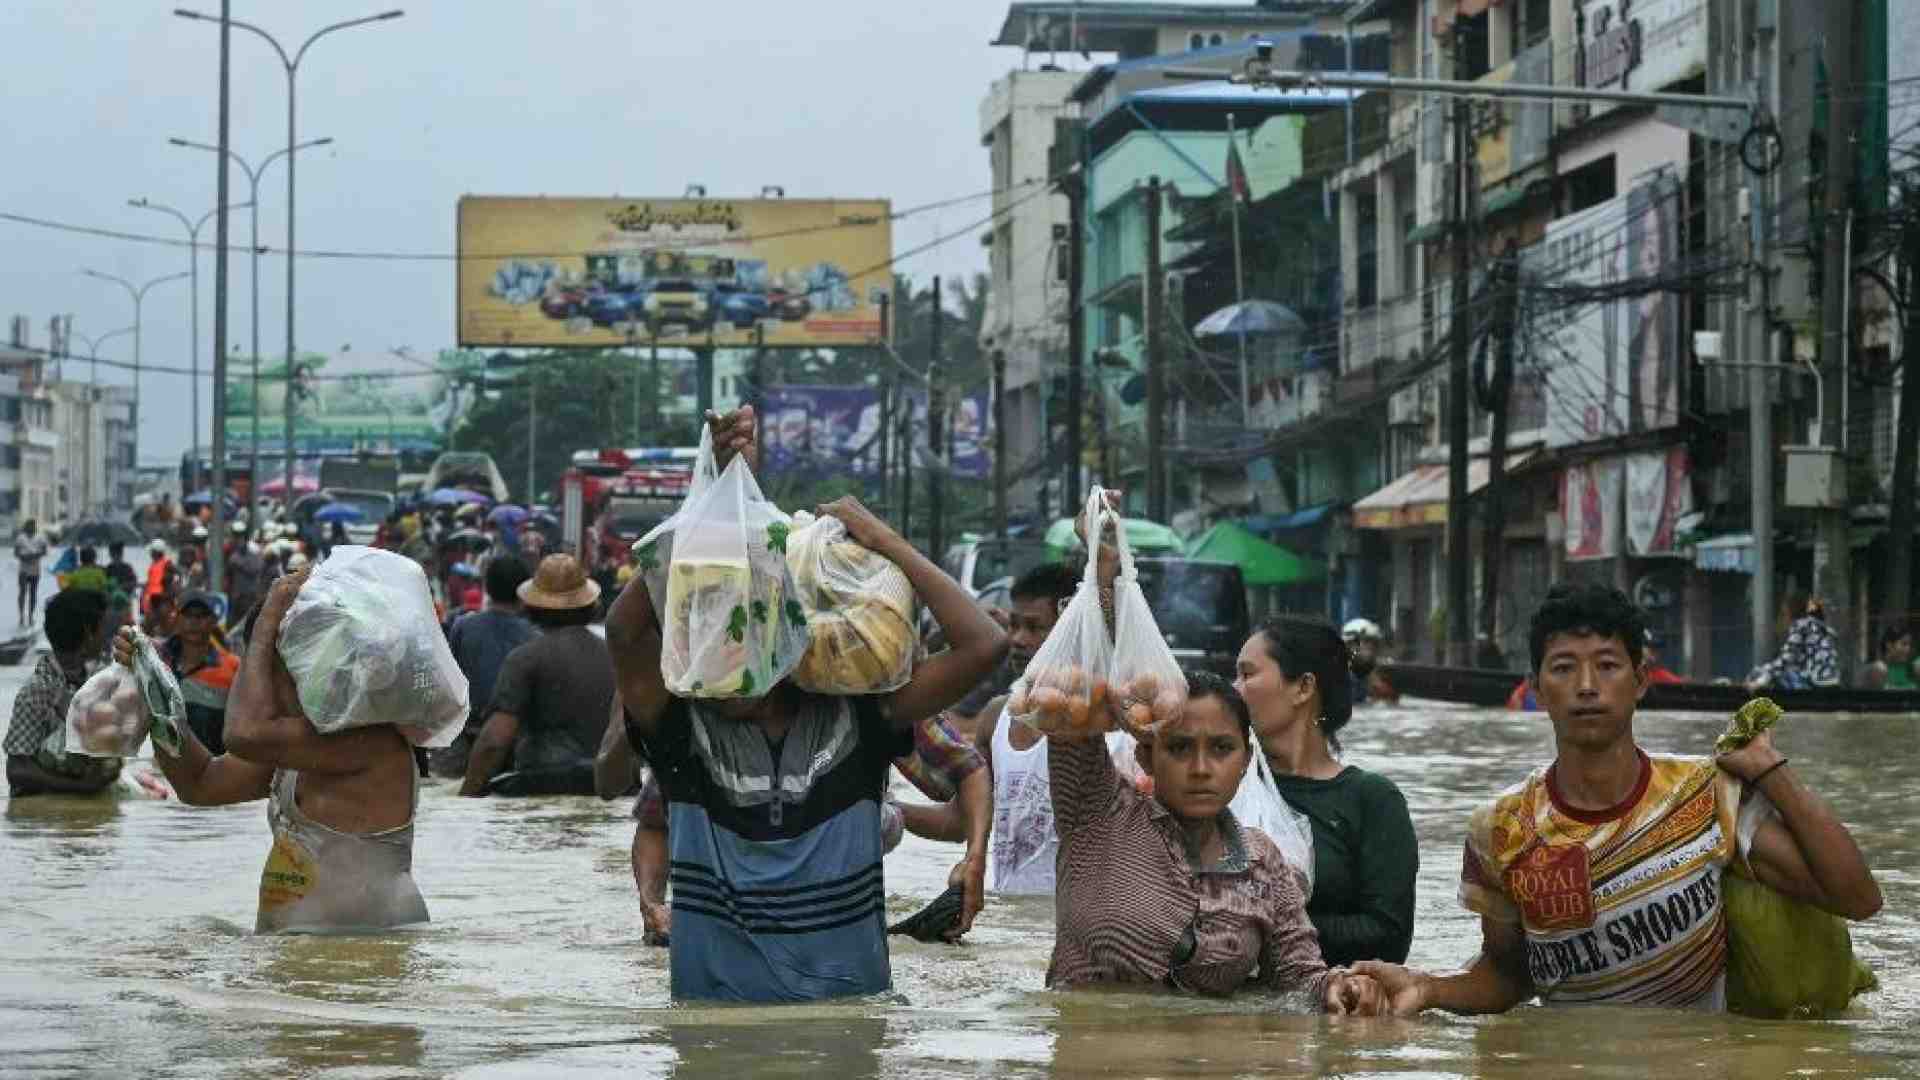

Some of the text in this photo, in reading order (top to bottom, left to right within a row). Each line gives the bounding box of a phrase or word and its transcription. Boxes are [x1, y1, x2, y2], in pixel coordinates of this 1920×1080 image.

[1510, 867, 1583, 898] ROYAL
[1527, 929, 1609, 982] OUBLE
[1605, 868, 1716, 963] SMOOTH
